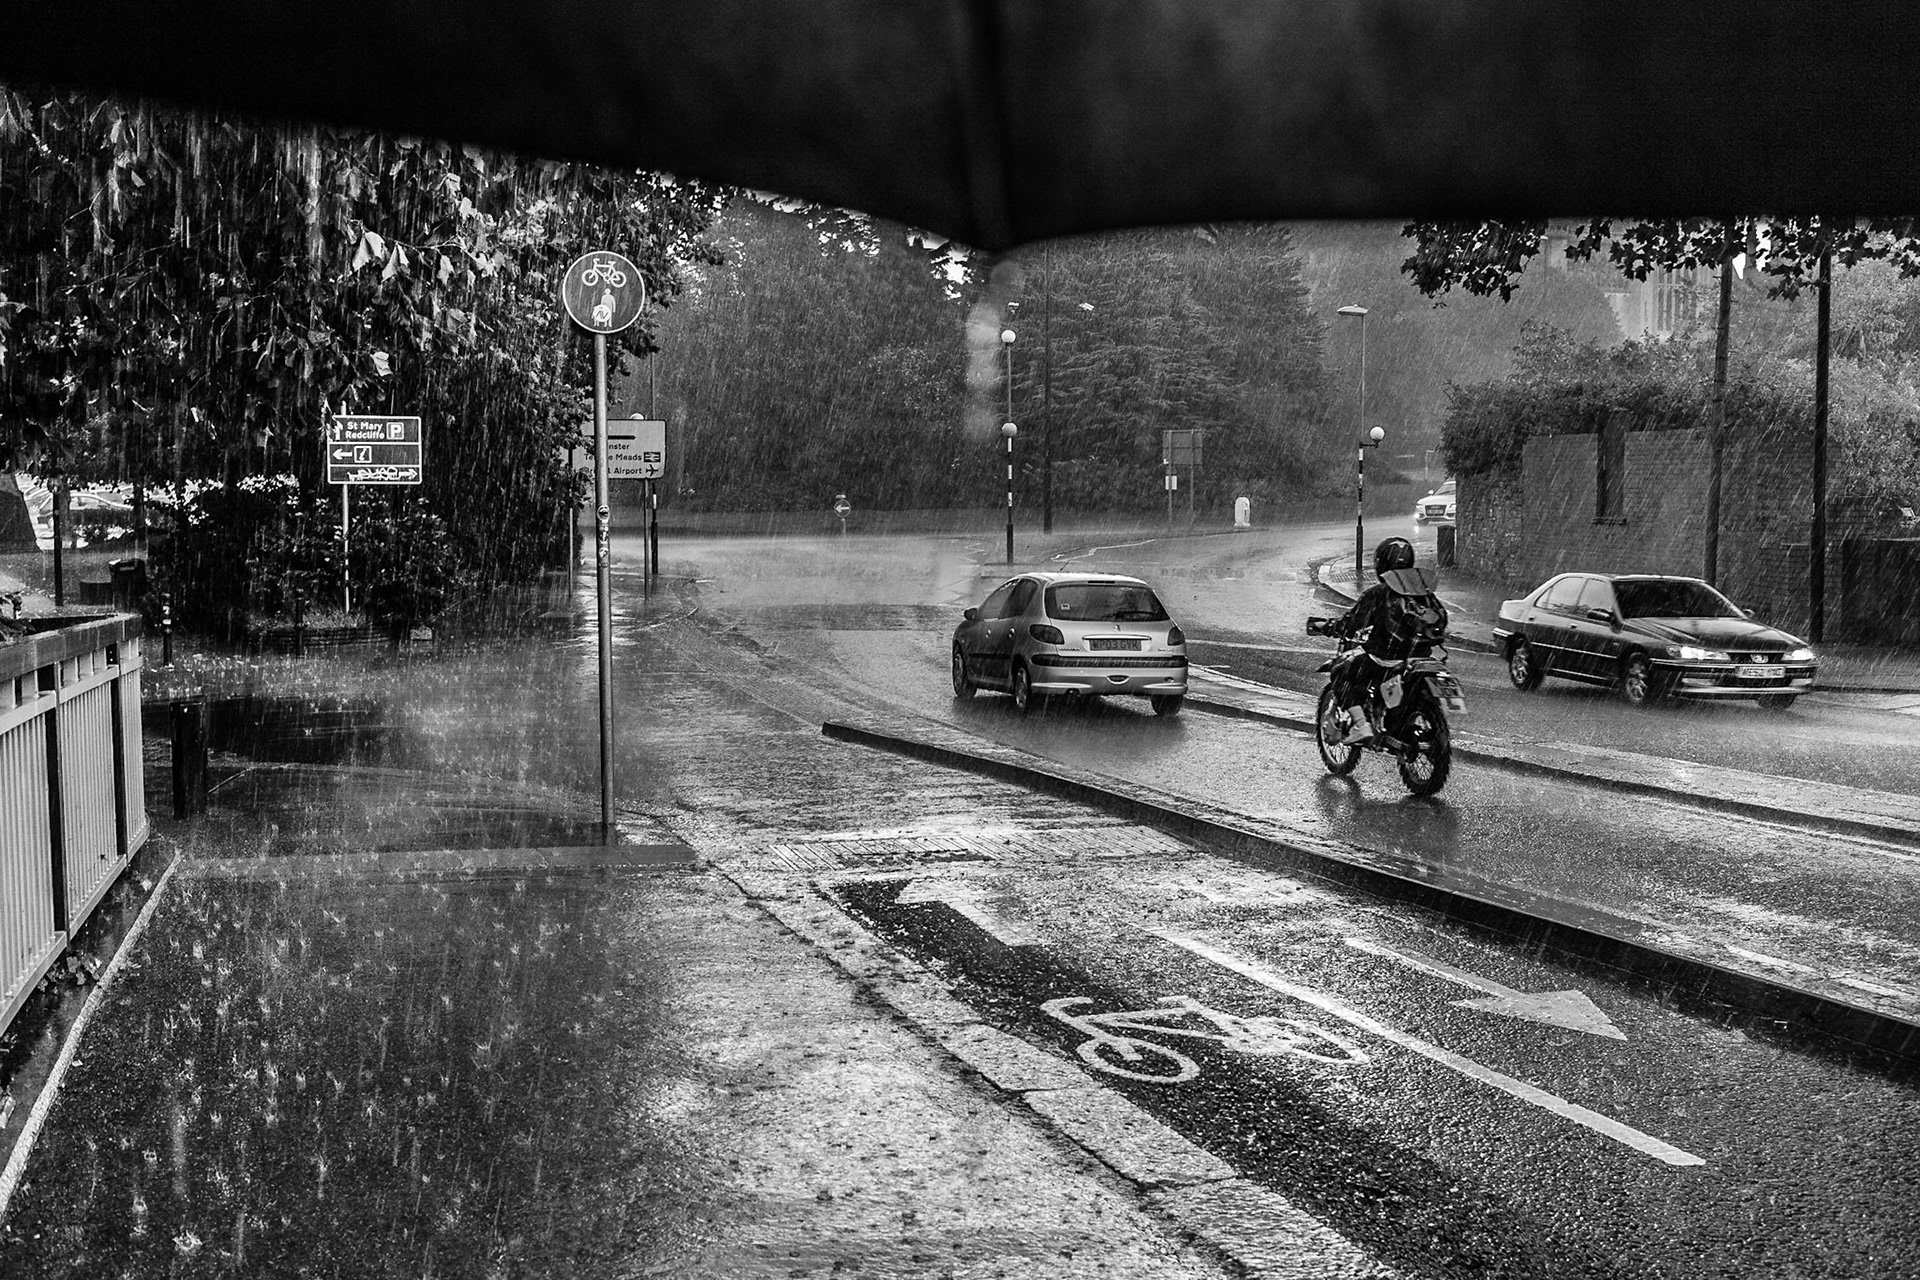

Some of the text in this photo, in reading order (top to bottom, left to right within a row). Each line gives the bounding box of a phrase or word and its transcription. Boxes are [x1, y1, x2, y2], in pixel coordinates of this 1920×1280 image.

[347, 421, 382, 431] St Mary
[345, 430, 384, 439] Redcliffe
